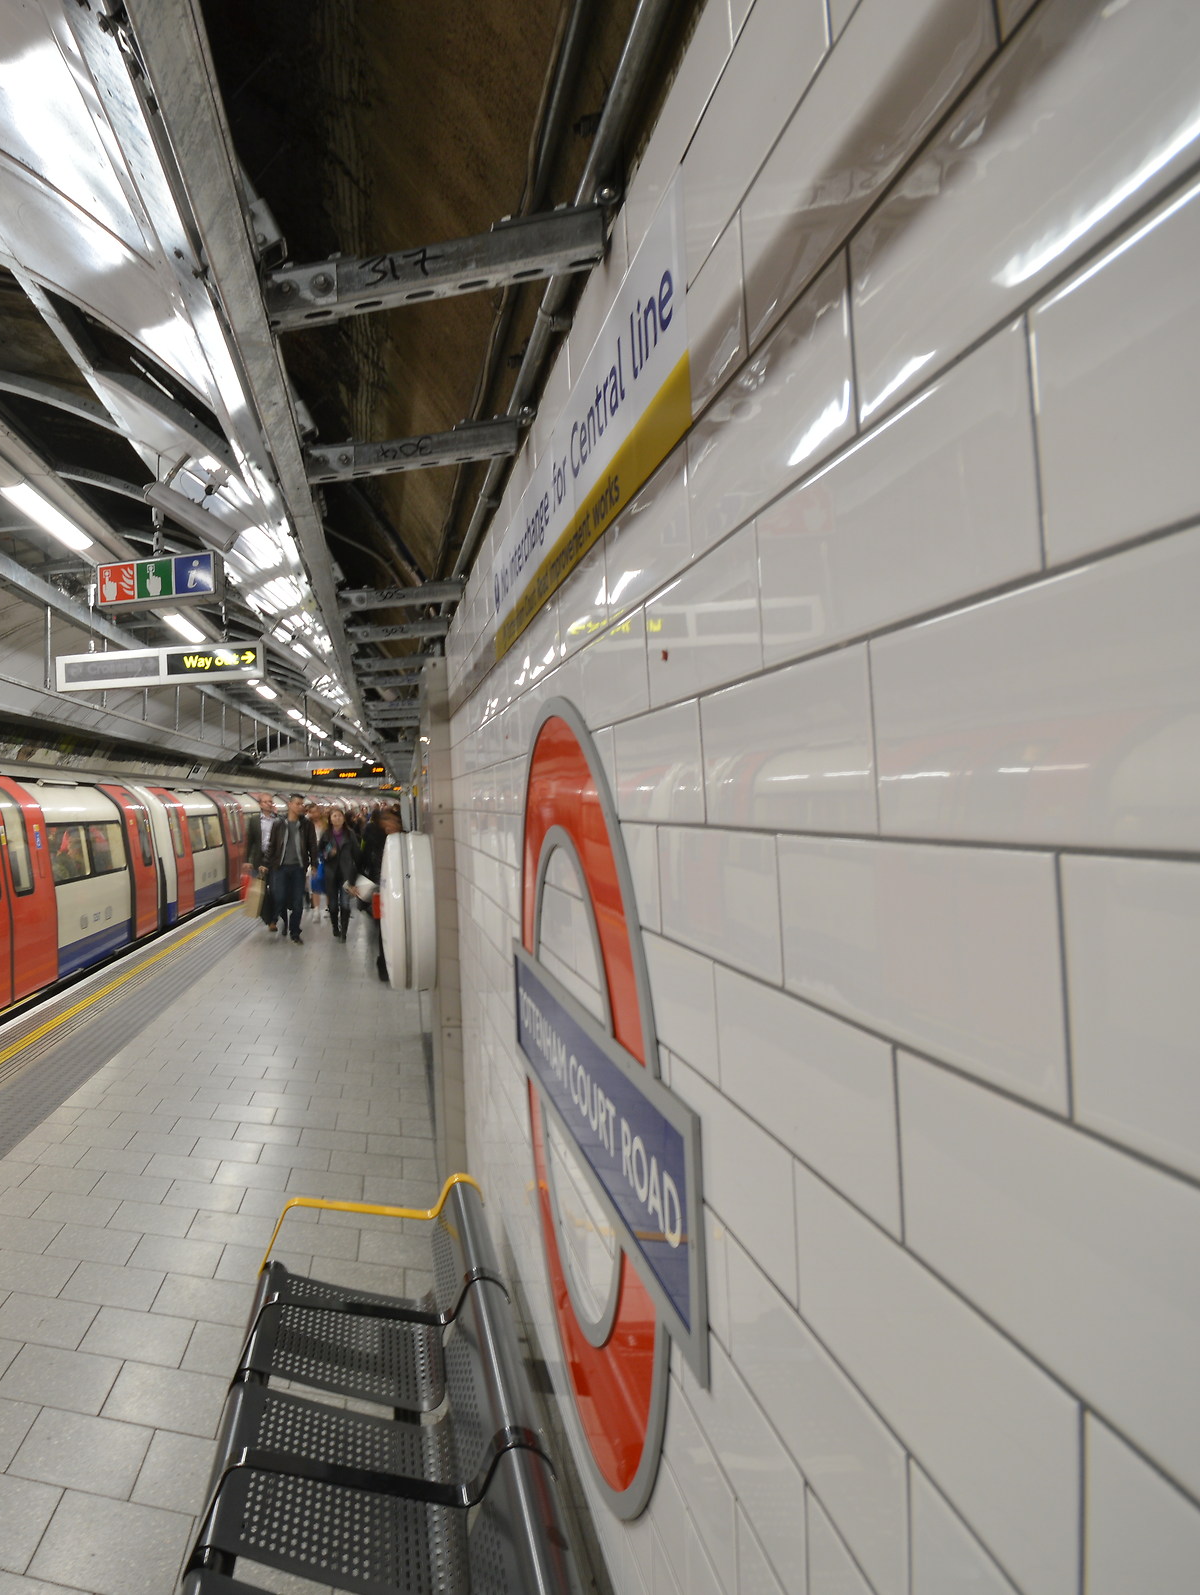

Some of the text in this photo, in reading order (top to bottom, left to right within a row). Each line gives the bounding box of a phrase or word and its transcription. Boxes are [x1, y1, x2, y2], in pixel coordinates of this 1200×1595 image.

[358, 248, 445, 287] 317
[509, 492, 550, 587] interchange
[553, 456, 567, 513] for
[570, 336, 626, 479] Central
[630, 269, 674, 380] line
[593, 475, 621, 529] works
[183, 655, 213, 670] Way
[519, 987, 682, 1248] TOTTENHAM COURT ROAD
